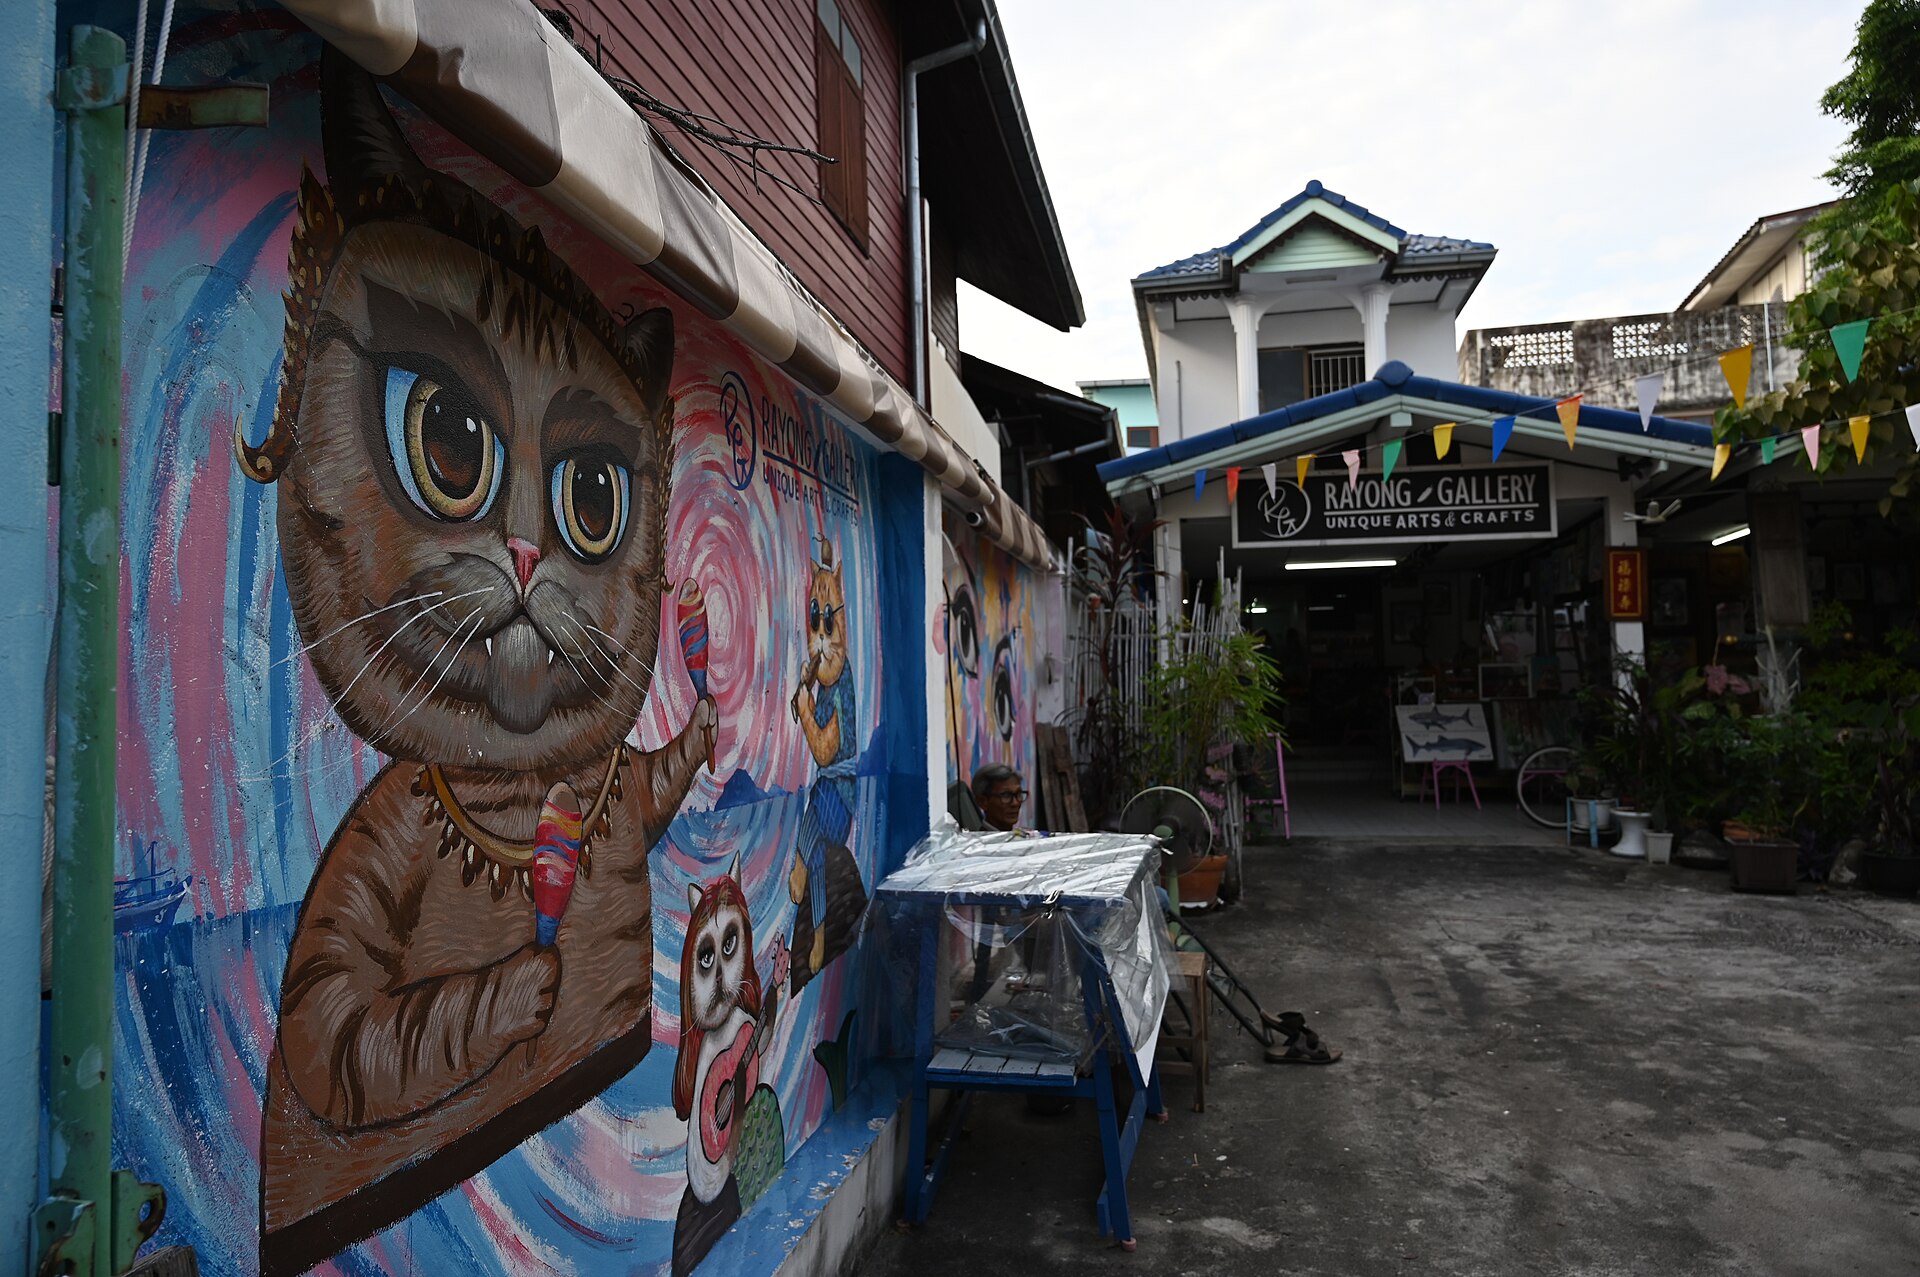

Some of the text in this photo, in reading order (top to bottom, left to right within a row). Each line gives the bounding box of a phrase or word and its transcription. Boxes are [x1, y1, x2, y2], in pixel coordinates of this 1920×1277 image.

[763, 396, 812, 470] RAYONG
[763, 463, 799, 503] UNIQUE
[804, 485, 824, 512] ART
[1325, 474, 1537, 510] RAYONG GALLERY
[1326, 510, 1536, 530] UNIQUE ARTS & CRAFTS
